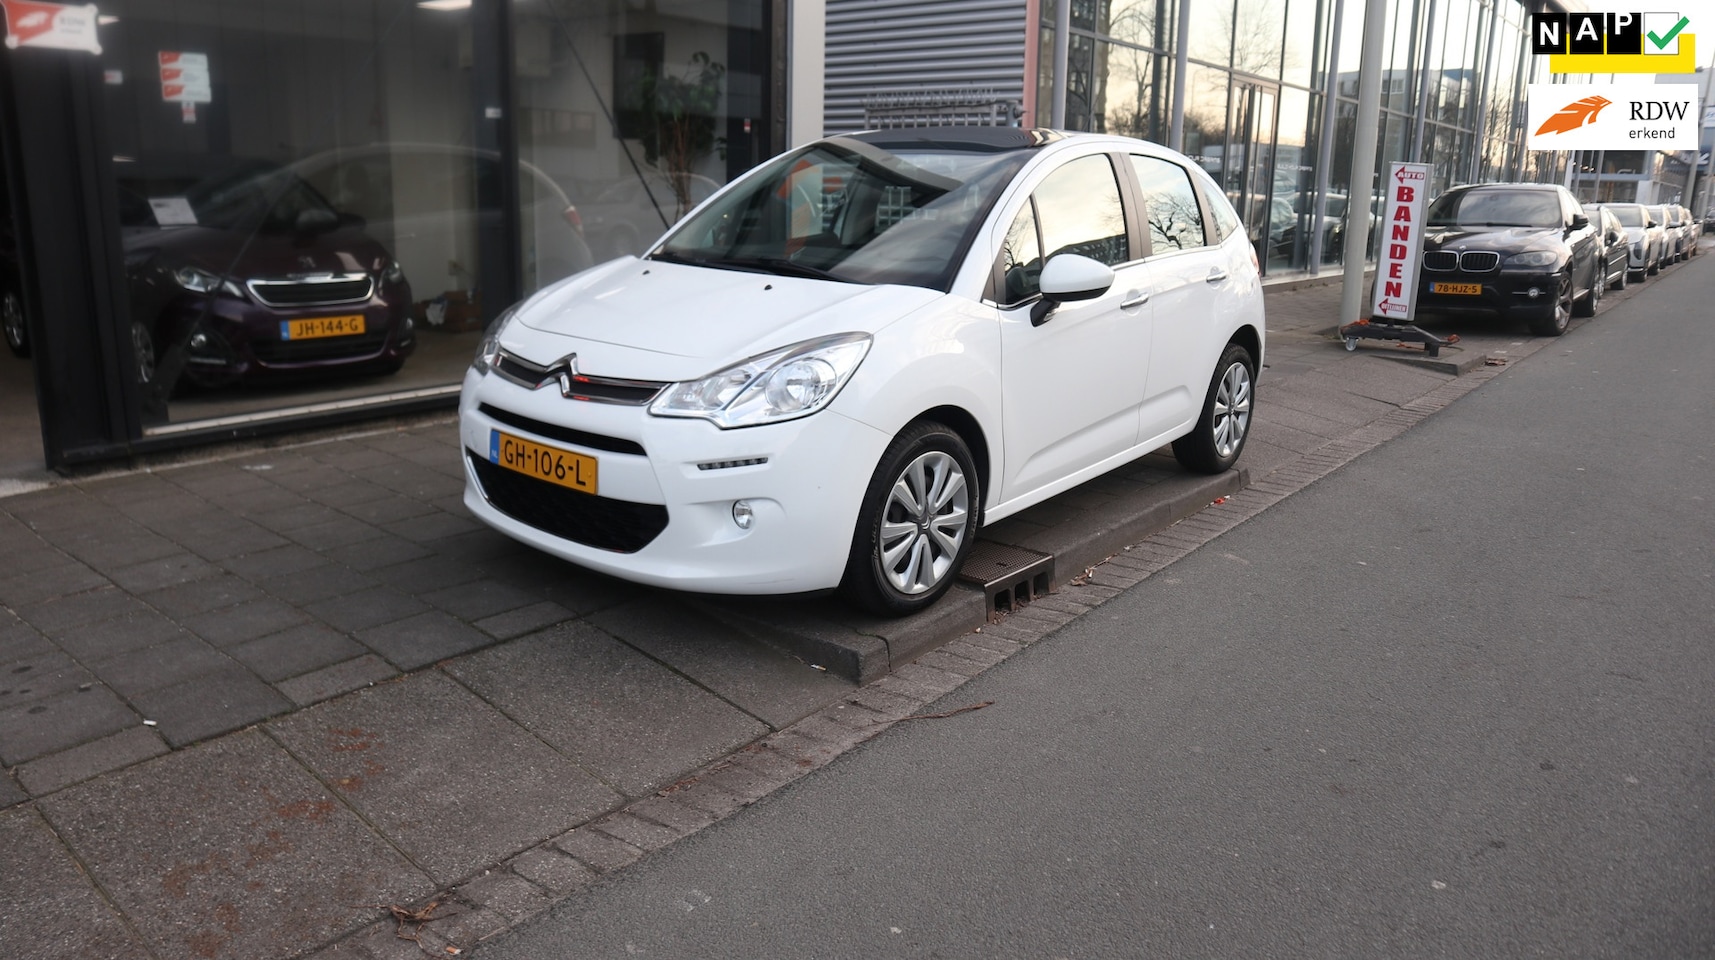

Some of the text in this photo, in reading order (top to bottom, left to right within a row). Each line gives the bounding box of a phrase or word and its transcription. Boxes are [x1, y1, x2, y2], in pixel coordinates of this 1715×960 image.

[1397, 171, 1424, 180] AUTO
[1384, 186, 1415, 298] BANDEN
[1438, 284, 1478, 294] 78-HJZ-5
[296, 318, 358, 337] JH-144-G
[504, 439, 587, 487] GH-106-L
